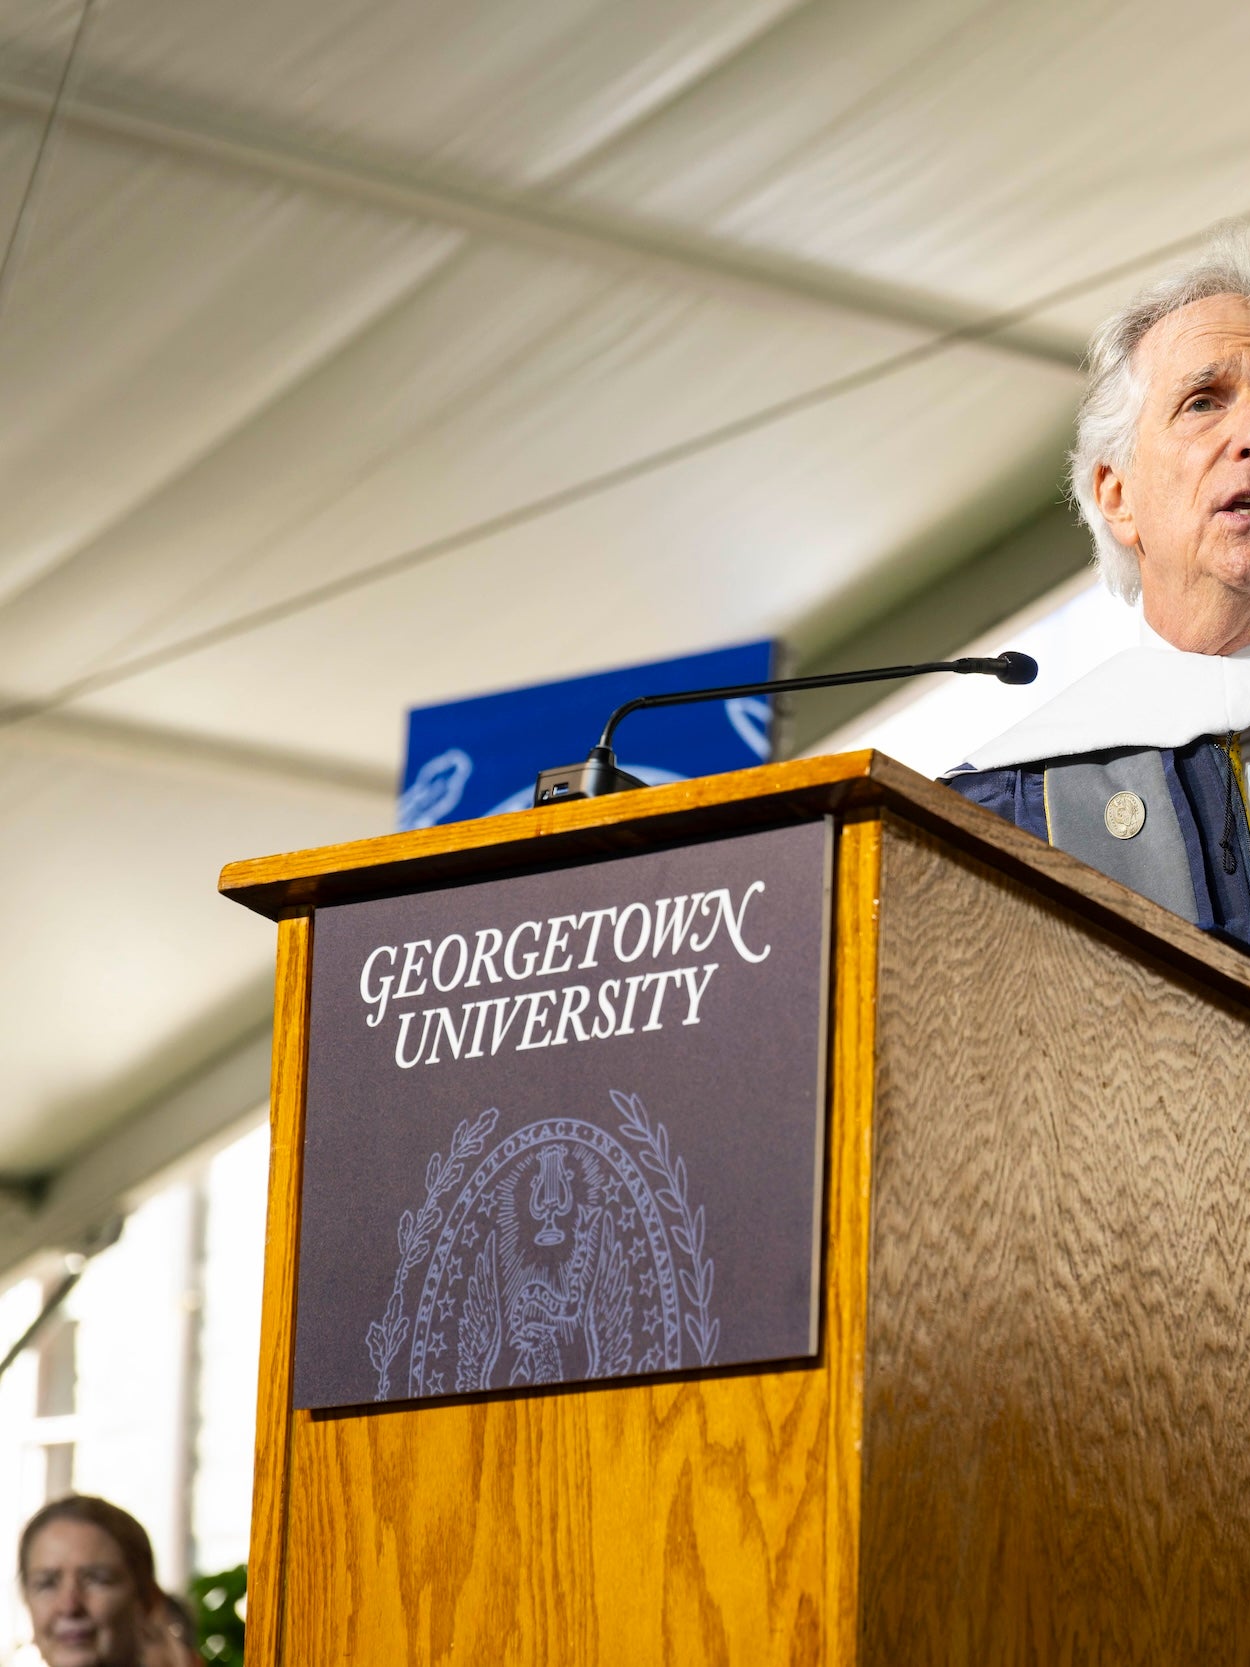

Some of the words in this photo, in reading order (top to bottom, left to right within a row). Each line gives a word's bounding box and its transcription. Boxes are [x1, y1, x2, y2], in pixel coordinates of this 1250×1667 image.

[360, 880, 772, 1028] GEORGETOWN
[394, 962, 720, 1069] UNIVERSITY
[459, 1121, 580, 1207] POTOMACI
[589, 1130, 614, 1155] IN
